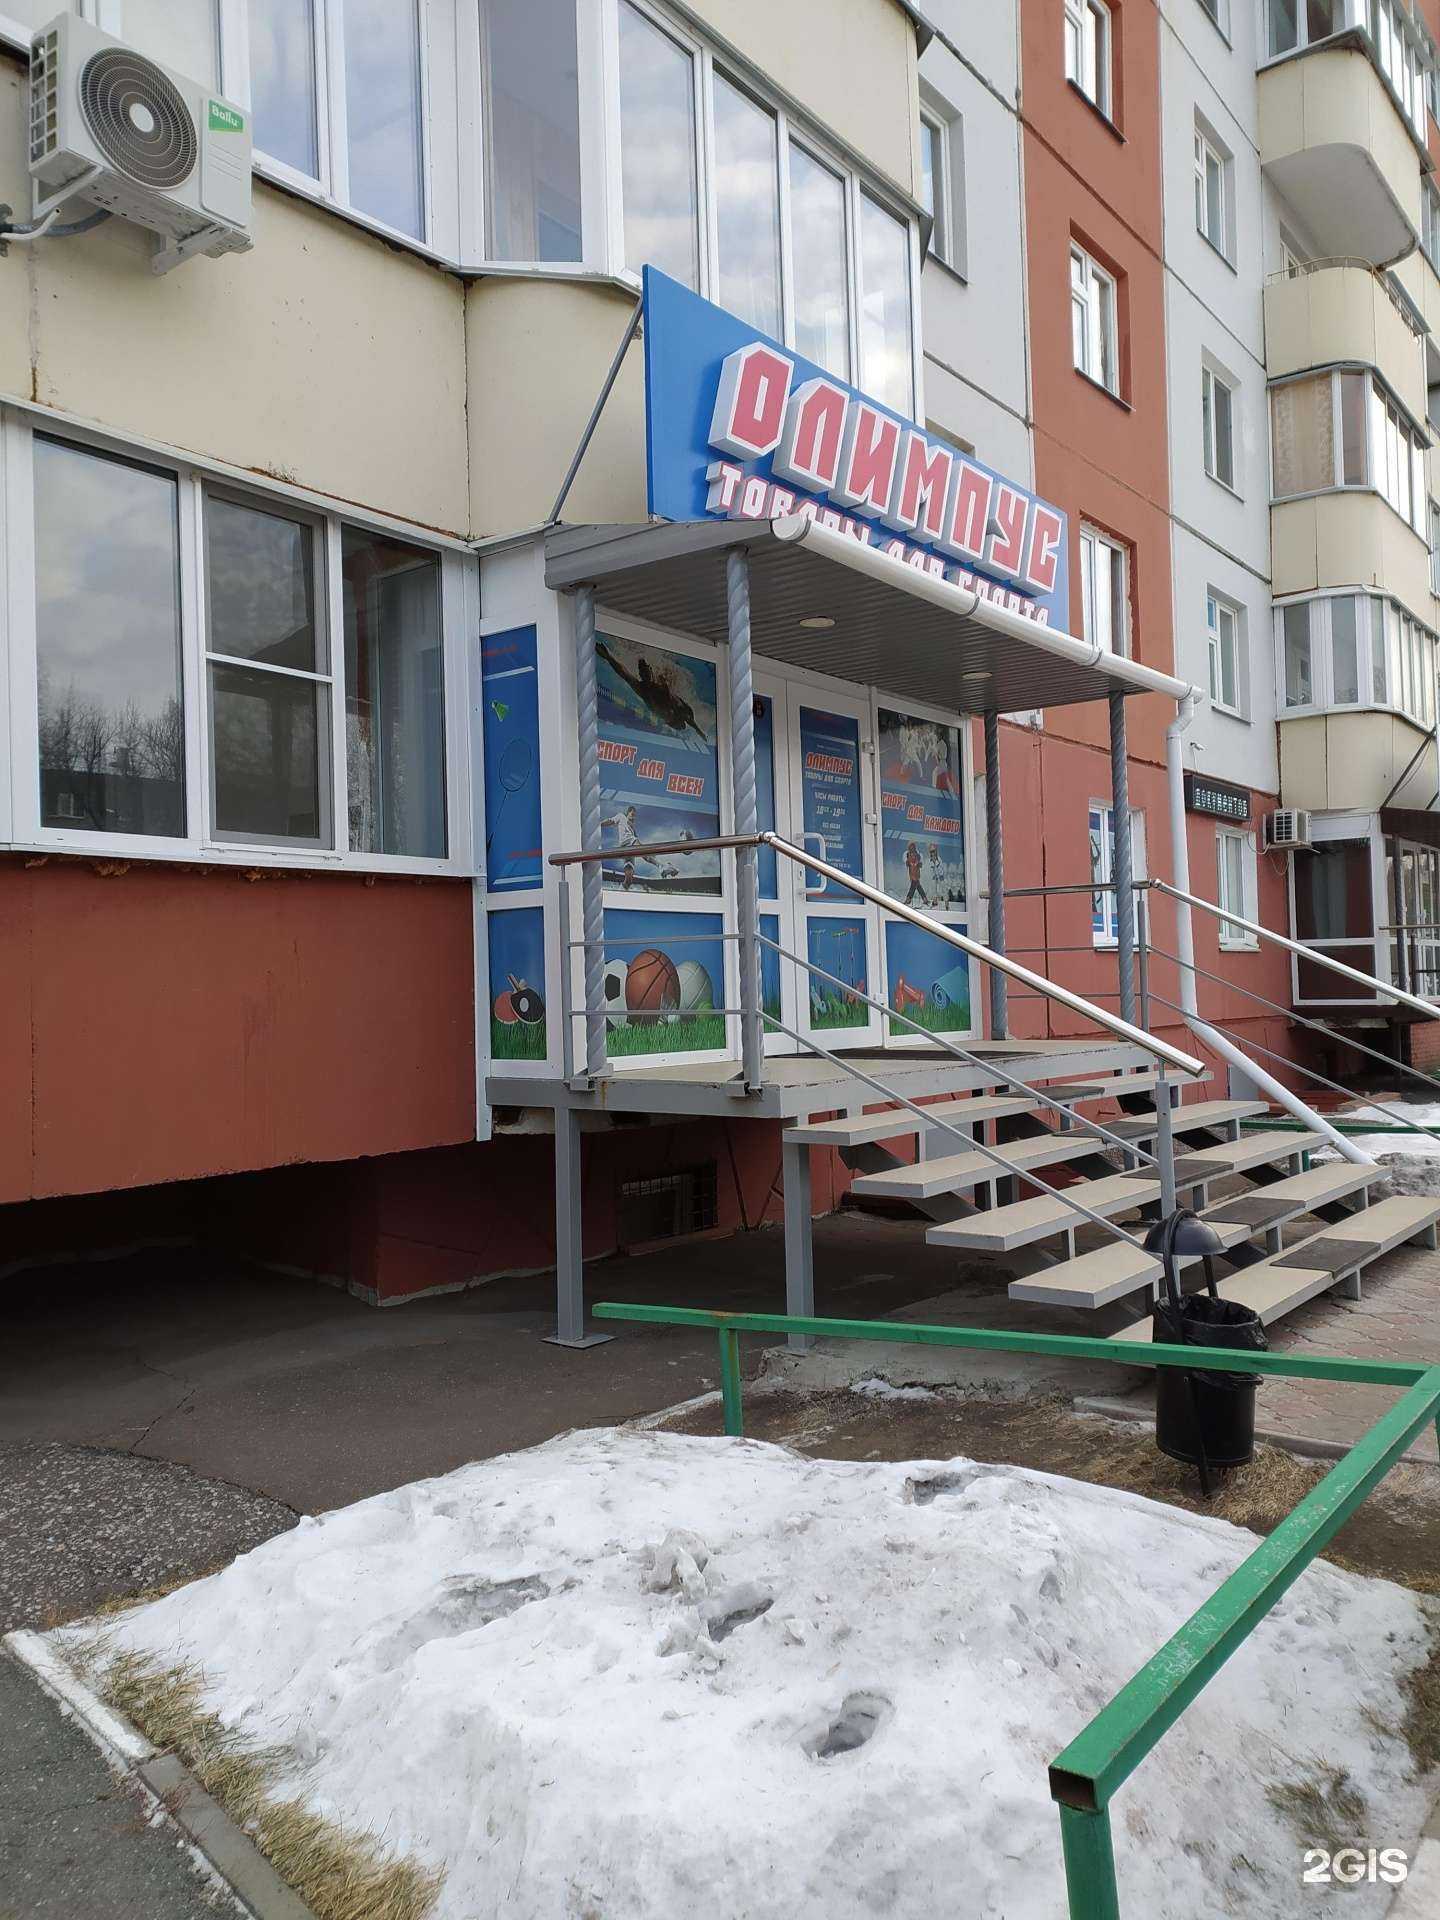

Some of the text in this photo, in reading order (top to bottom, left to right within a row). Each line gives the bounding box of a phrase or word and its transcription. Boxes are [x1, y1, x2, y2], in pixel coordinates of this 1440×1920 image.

[211, 104, 239, 127] Ballu
[709, 342, 1063, 596] ОЛИМПУС
[597, 740, 705, 797] СПОРТ ДЛЯ ВСЕХ
[805, 752, 854, 776] ОЛИМПУС
[882, 792, 960, 834] СПОРТ ДЛЯ КАЖДОГО
